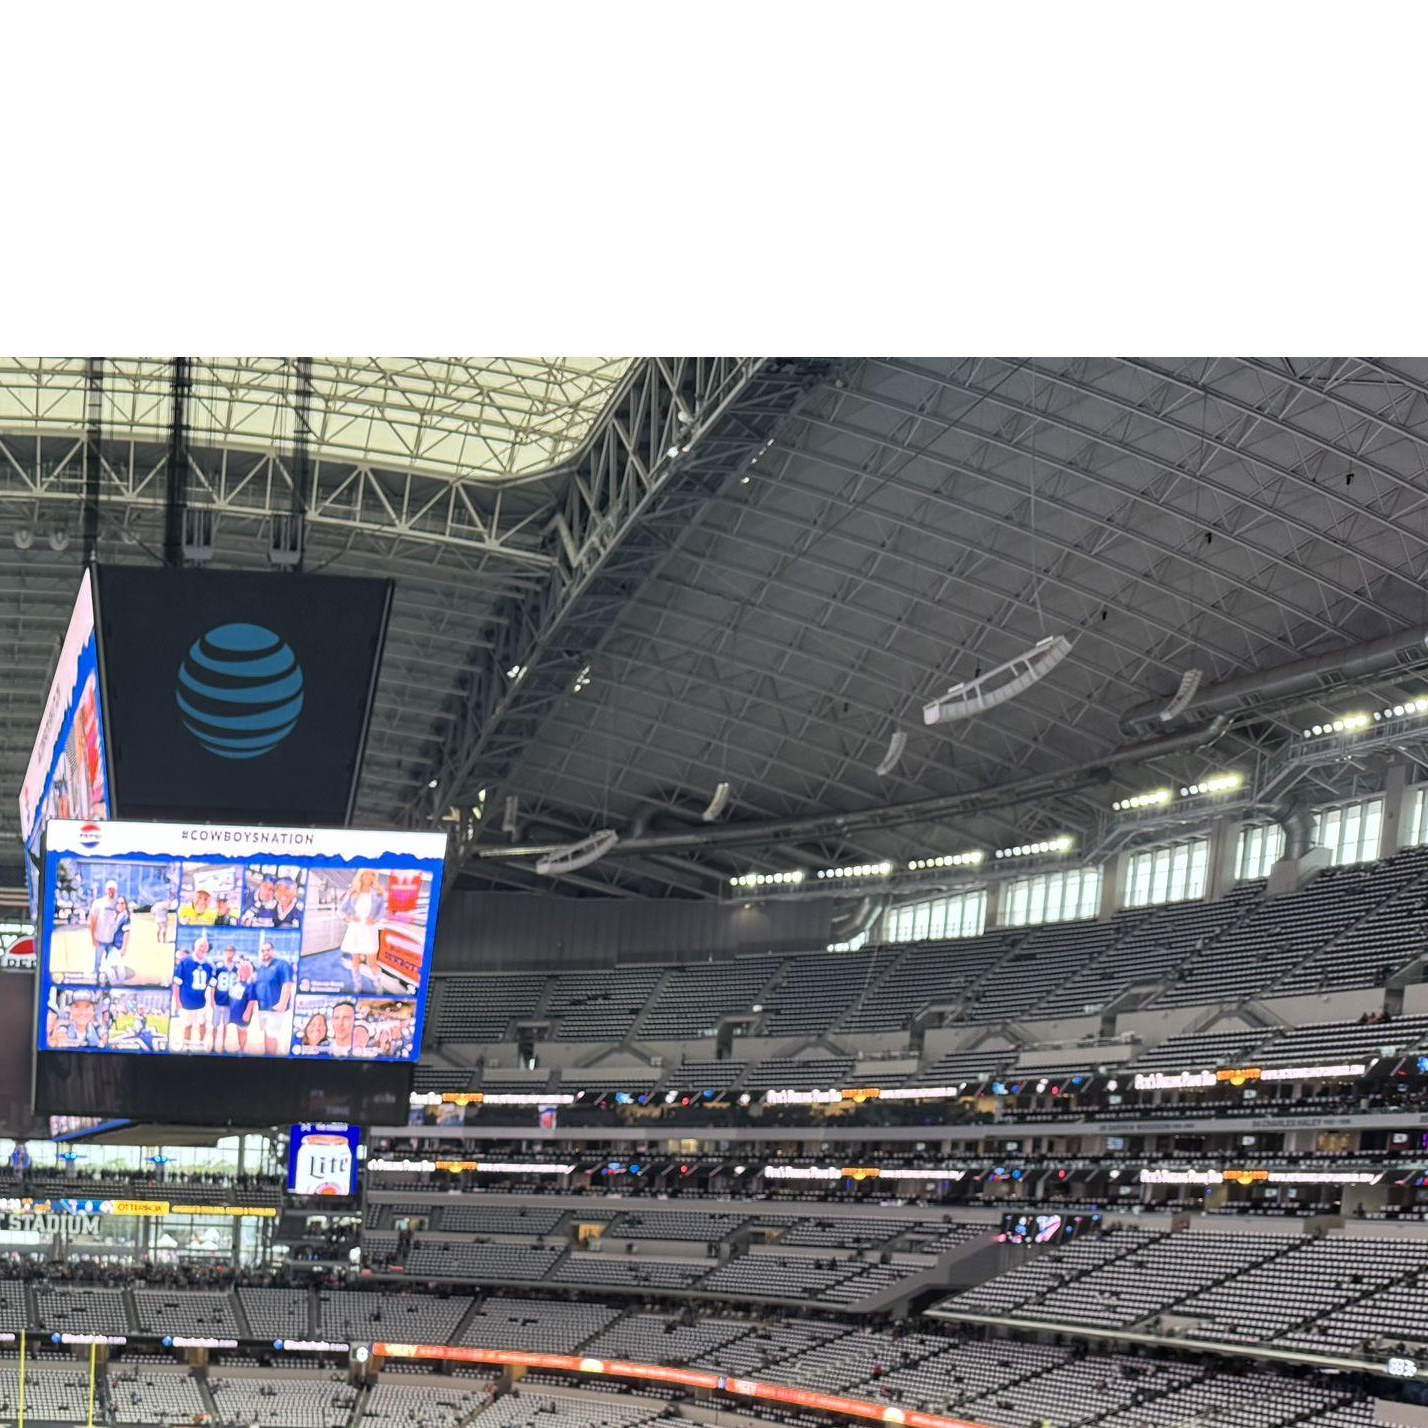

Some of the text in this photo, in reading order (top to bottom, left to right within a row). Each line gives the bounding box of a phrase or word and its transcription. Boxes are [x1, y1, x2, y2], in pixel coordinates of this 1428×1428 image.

[181, 830, 315, 846] #COWBOYSNATION
[310, 1155, 349, 1180] Lite
[8, 1213, 101, 1236] STADIUM
